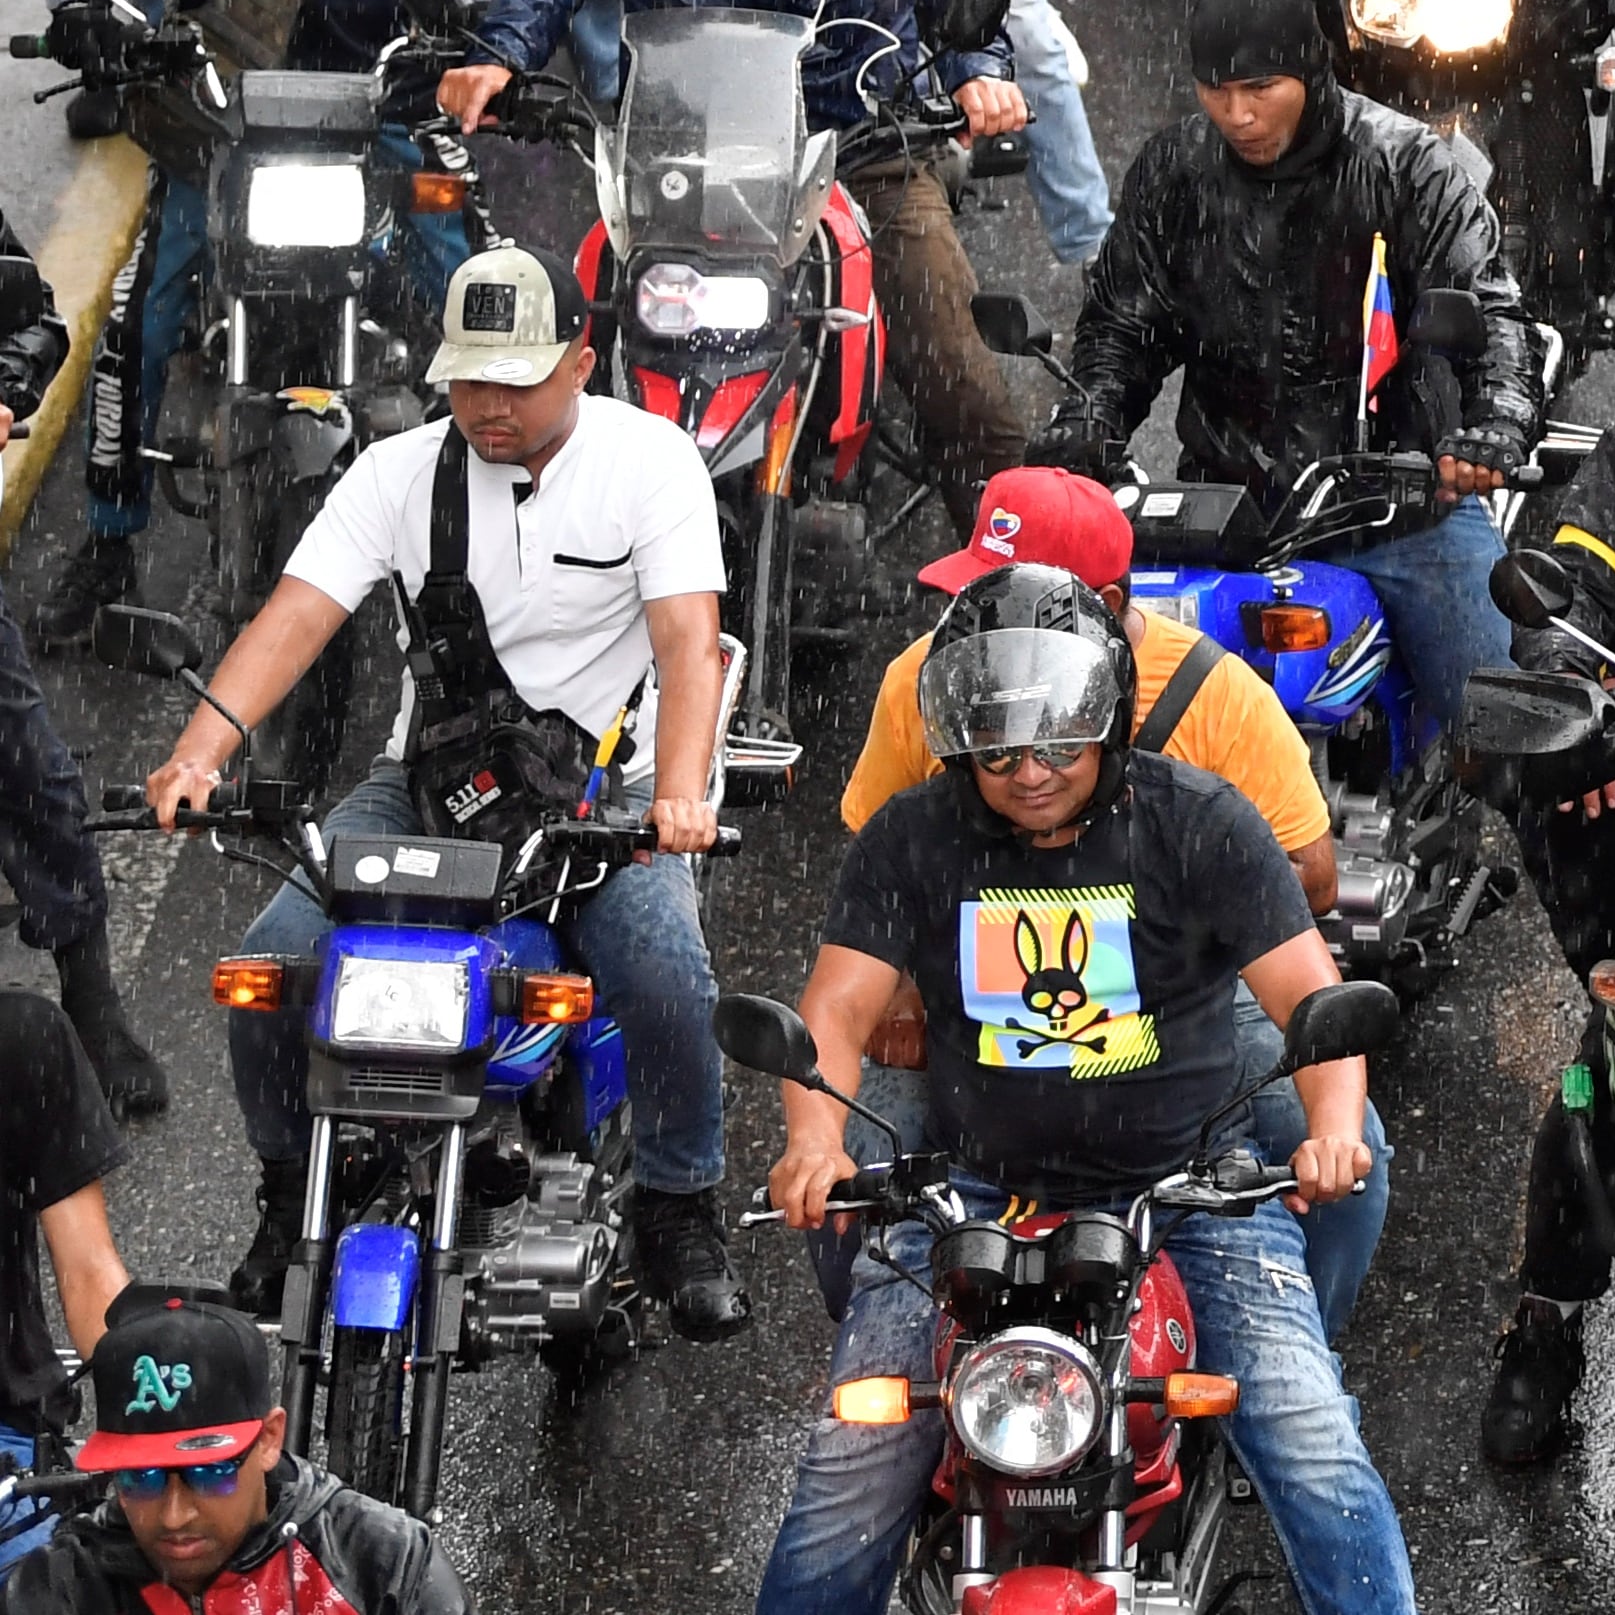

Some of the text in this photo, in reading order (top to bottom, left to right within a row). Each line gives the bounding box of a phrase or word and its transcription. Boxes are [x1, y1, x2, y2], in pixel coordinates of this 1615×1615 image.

[471, 295, 506, 316] VEN
[90, 369, 125, 468] JORDAN
[971, 682, 1053, 706] LS2
[445, 782, 480, 814] 5.11
[125, 1354, 193, 1417] A's
[1006, 1487, 1079, 1508] YAMAHA
